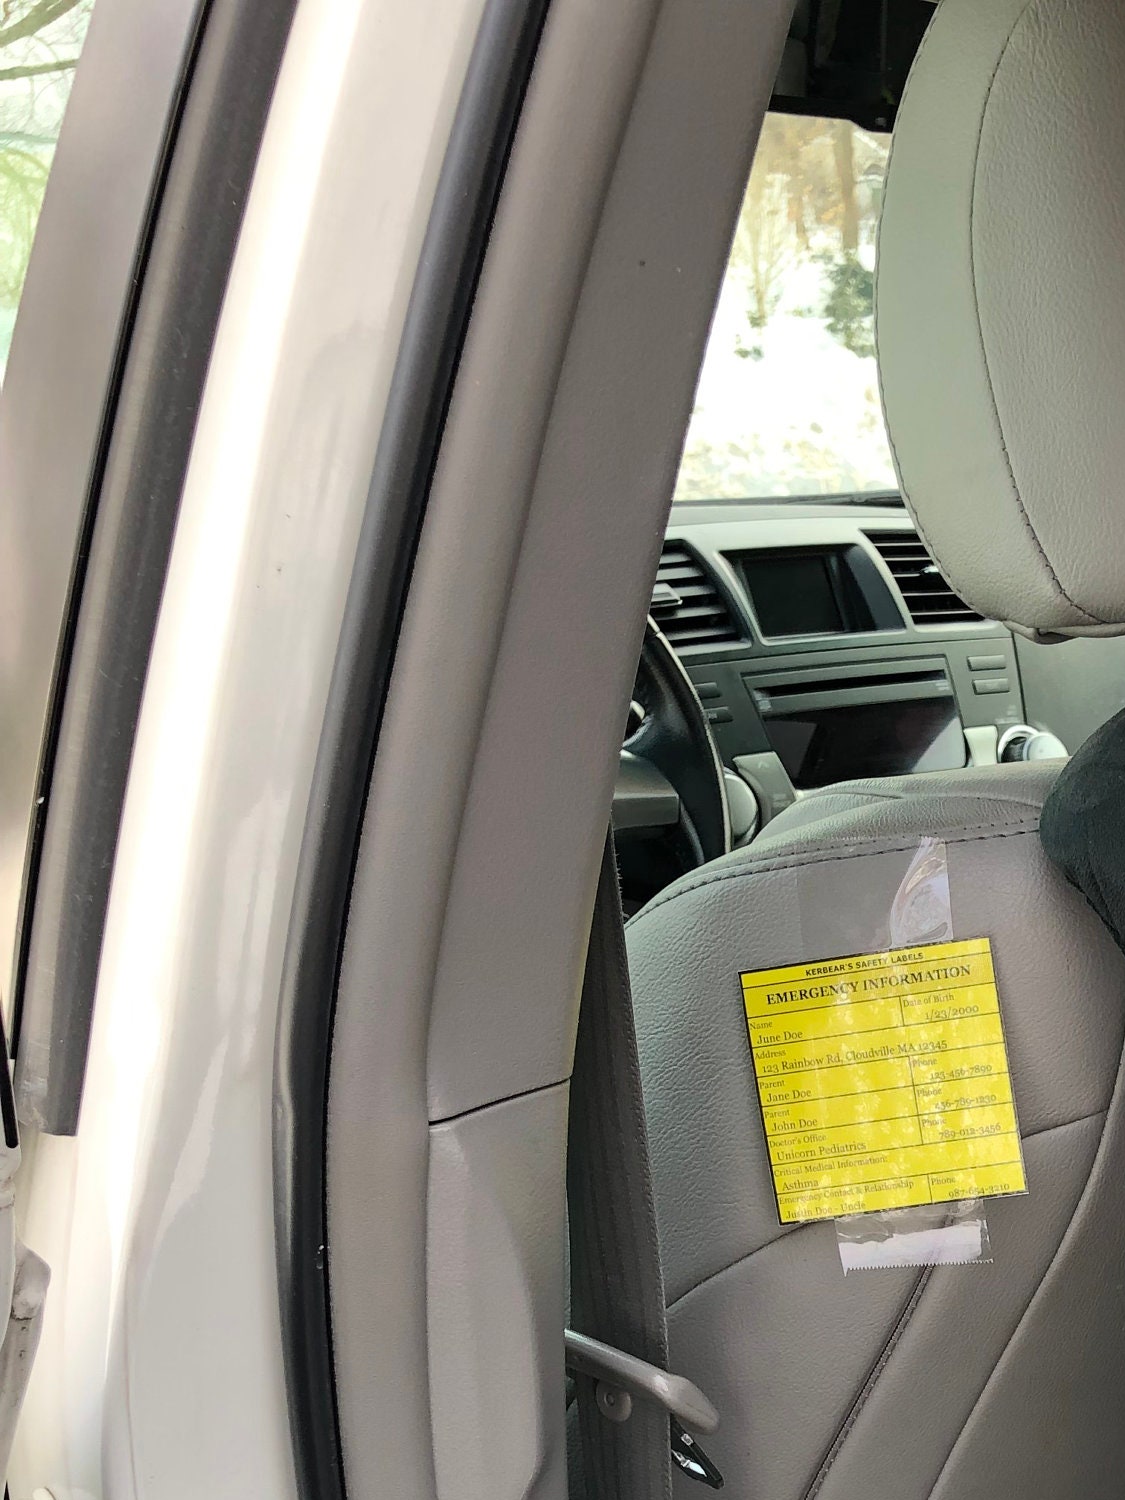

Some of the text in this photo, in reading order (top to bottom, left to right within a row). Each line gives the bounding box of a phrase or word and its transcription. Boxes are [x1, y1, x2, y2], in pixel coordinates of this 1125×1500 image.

[805, 952, 924, 977] KERBEAR'S SAFETY LABELS
[766, 965, 971, 1005] EMERGENCY INFORMATION
[903, 993, 955, 1008] Date of Birth
[925, 1005, 980, 1021] 1/23/2000
[750, 1020, 773, 1030] Name
[757, 1031, 803, 1045] June Doe
[755, 1049, 787, 1060] Address
[762, 1040, 948, 1074] 123 Rainbow Rd, Cloudville MA 12345
[912, 1057, 938, 1068] Phone
[930, 1064, 992, 1081] 123-456-7890
[760, 1079, 785, 1090] Parent
[766, 1089, 812, 1103] Jane Doe
[917, 1087, 942, 1098] Phone
[764, 1109, 790, 1119] Parent
[772, 1118, 818, 1132] John Doe
[922, 1118, 947, 1128] Phone
[769, 1133, 827, 1148] Doctor's Office
[777, 1141, 867, 1161] Unicorn Pediatrics
[774, 1156, 888, 1178] Critical Medical Information:
[782, 1179, 819, 1192] Asthma
[931, 1175, 956, 1186] Phone
[780, 1192, 822, 1205] Emergency
[824, 1188, 853, 1199] Contact
[865, 1180, 914, 1193] Relationship
[786, 1209, 814, 1220] Justin
[816, 1206, 833, 1216] Doe
[841, 1201, 866, 1213] Uncle
